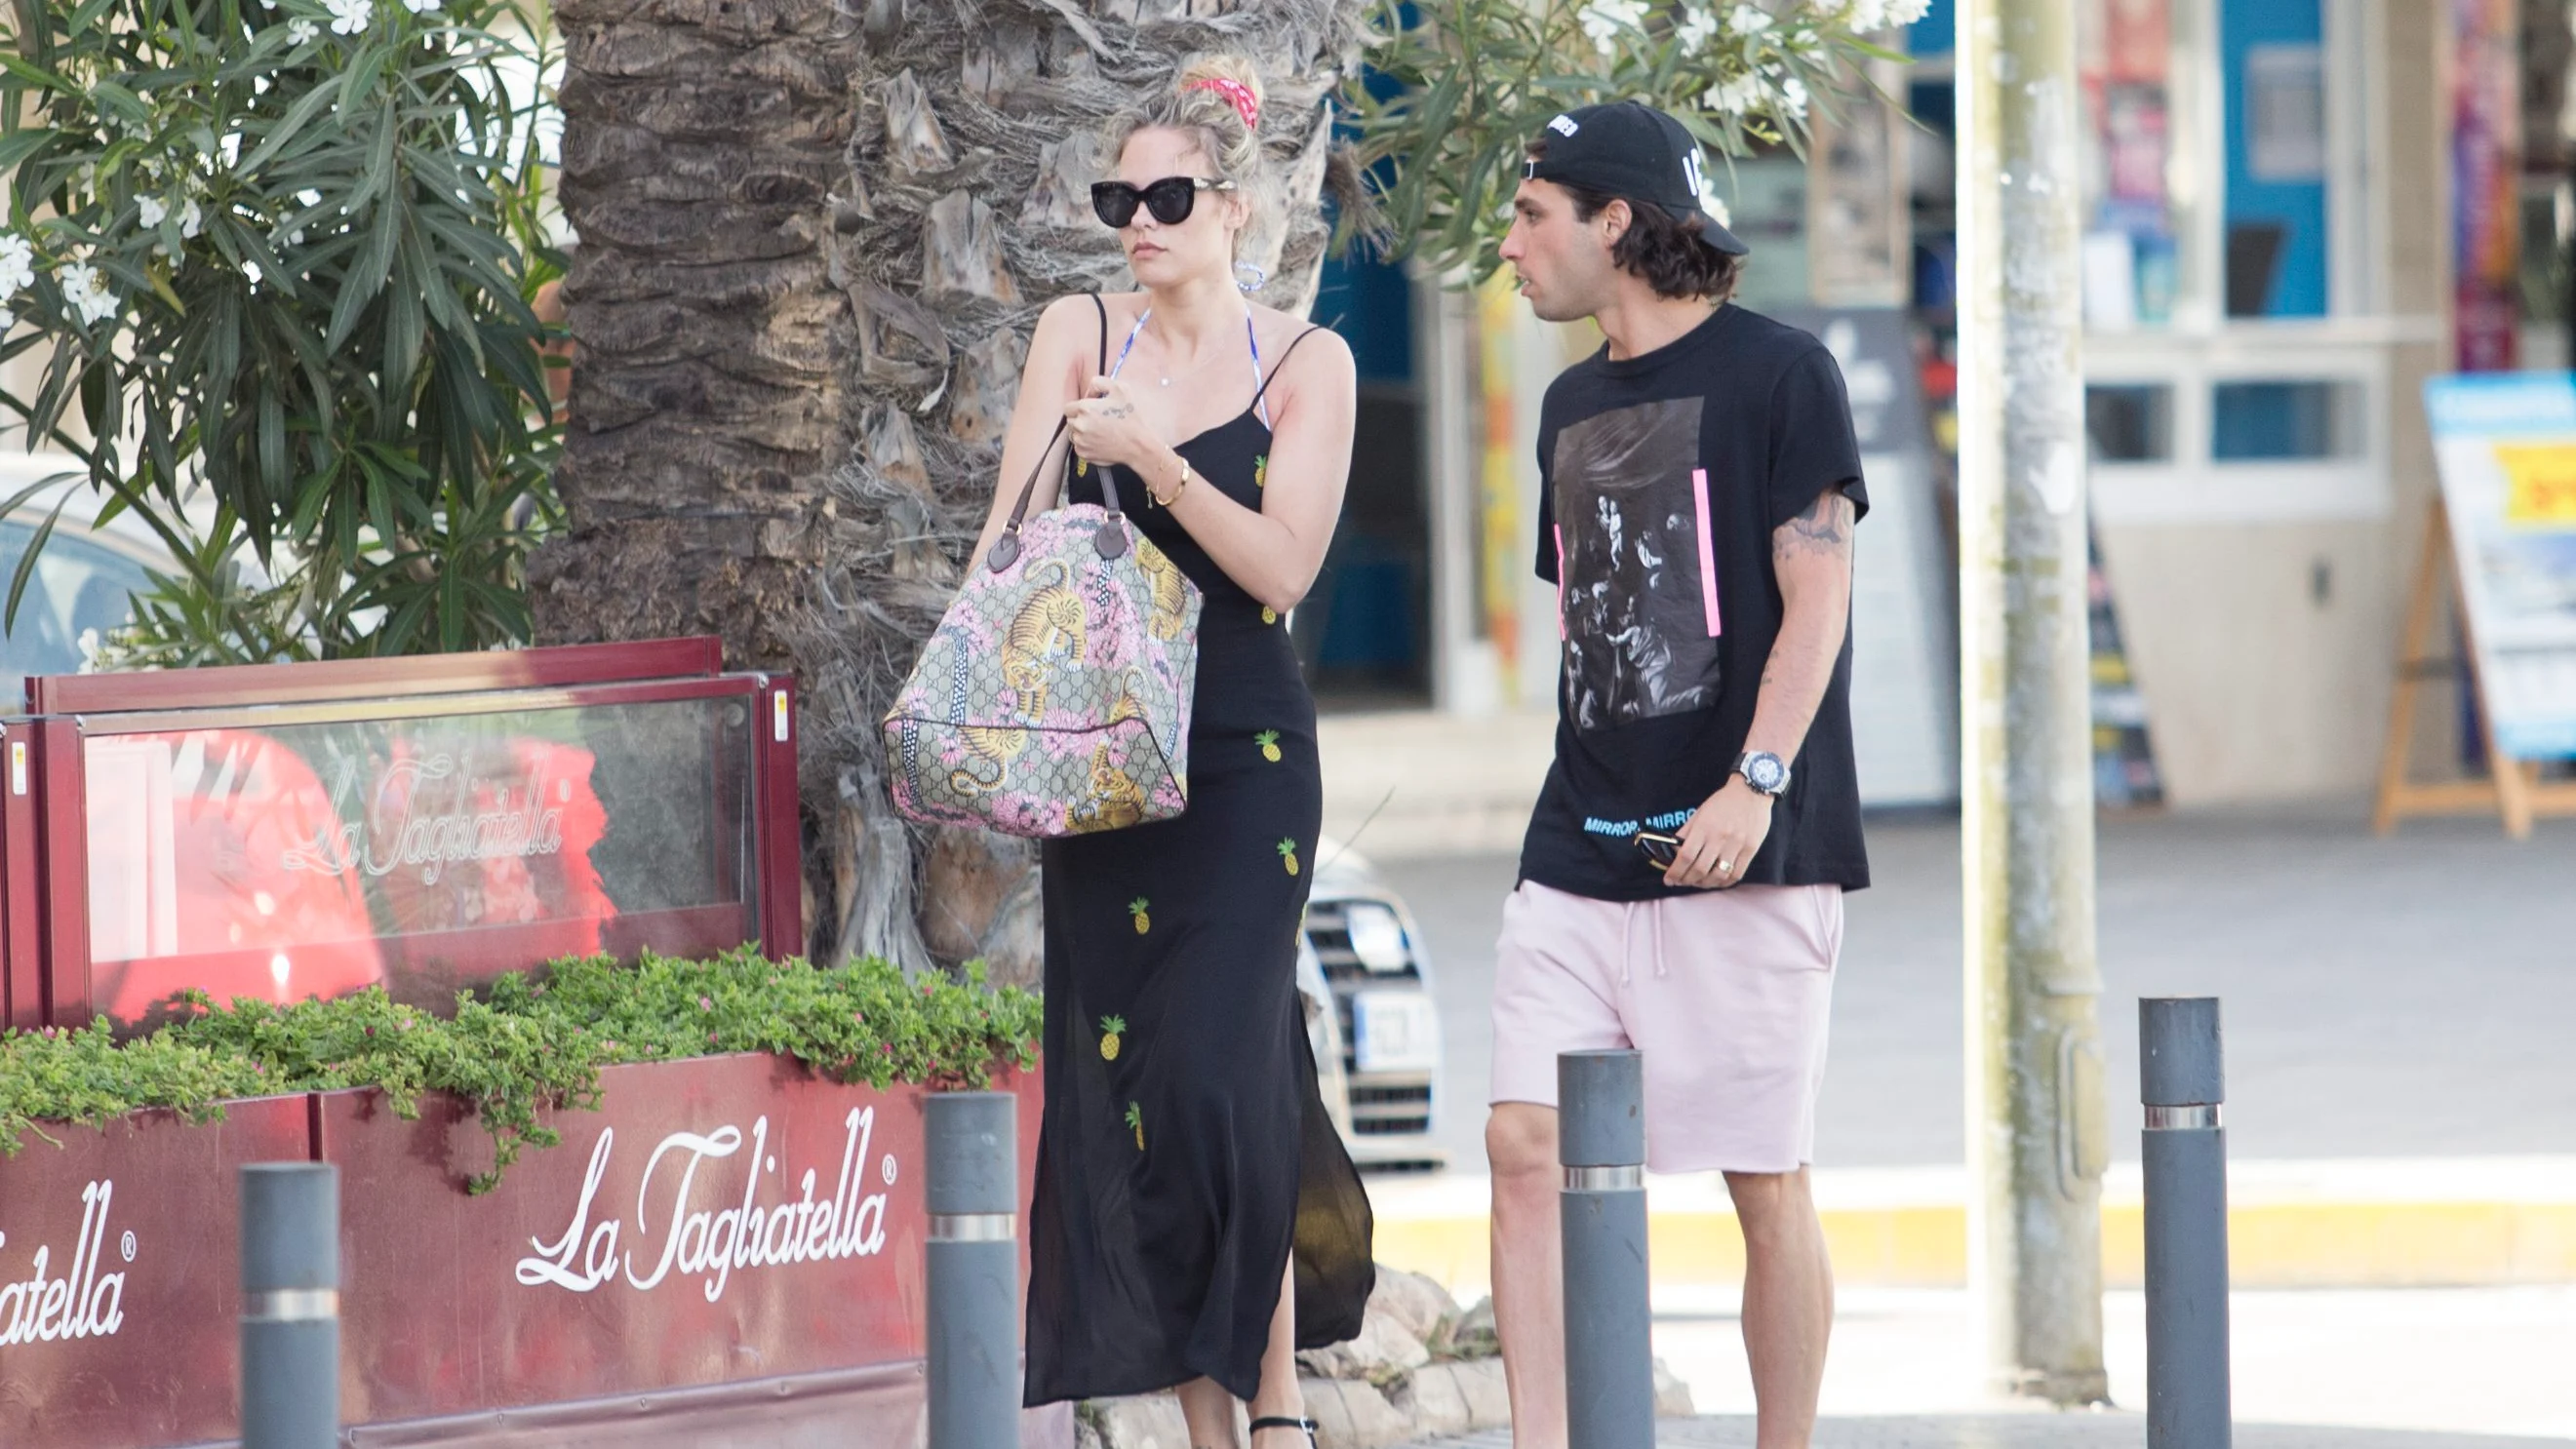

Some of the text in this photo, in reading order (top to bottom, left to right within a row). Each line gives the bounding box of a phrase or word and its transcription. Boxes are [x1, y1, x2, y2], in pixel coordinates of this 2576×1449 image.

[282, 755, 362, 876] La
[1645, 807, 1698, 829] MIRRO
[515, 1126, 621, 1292] La
